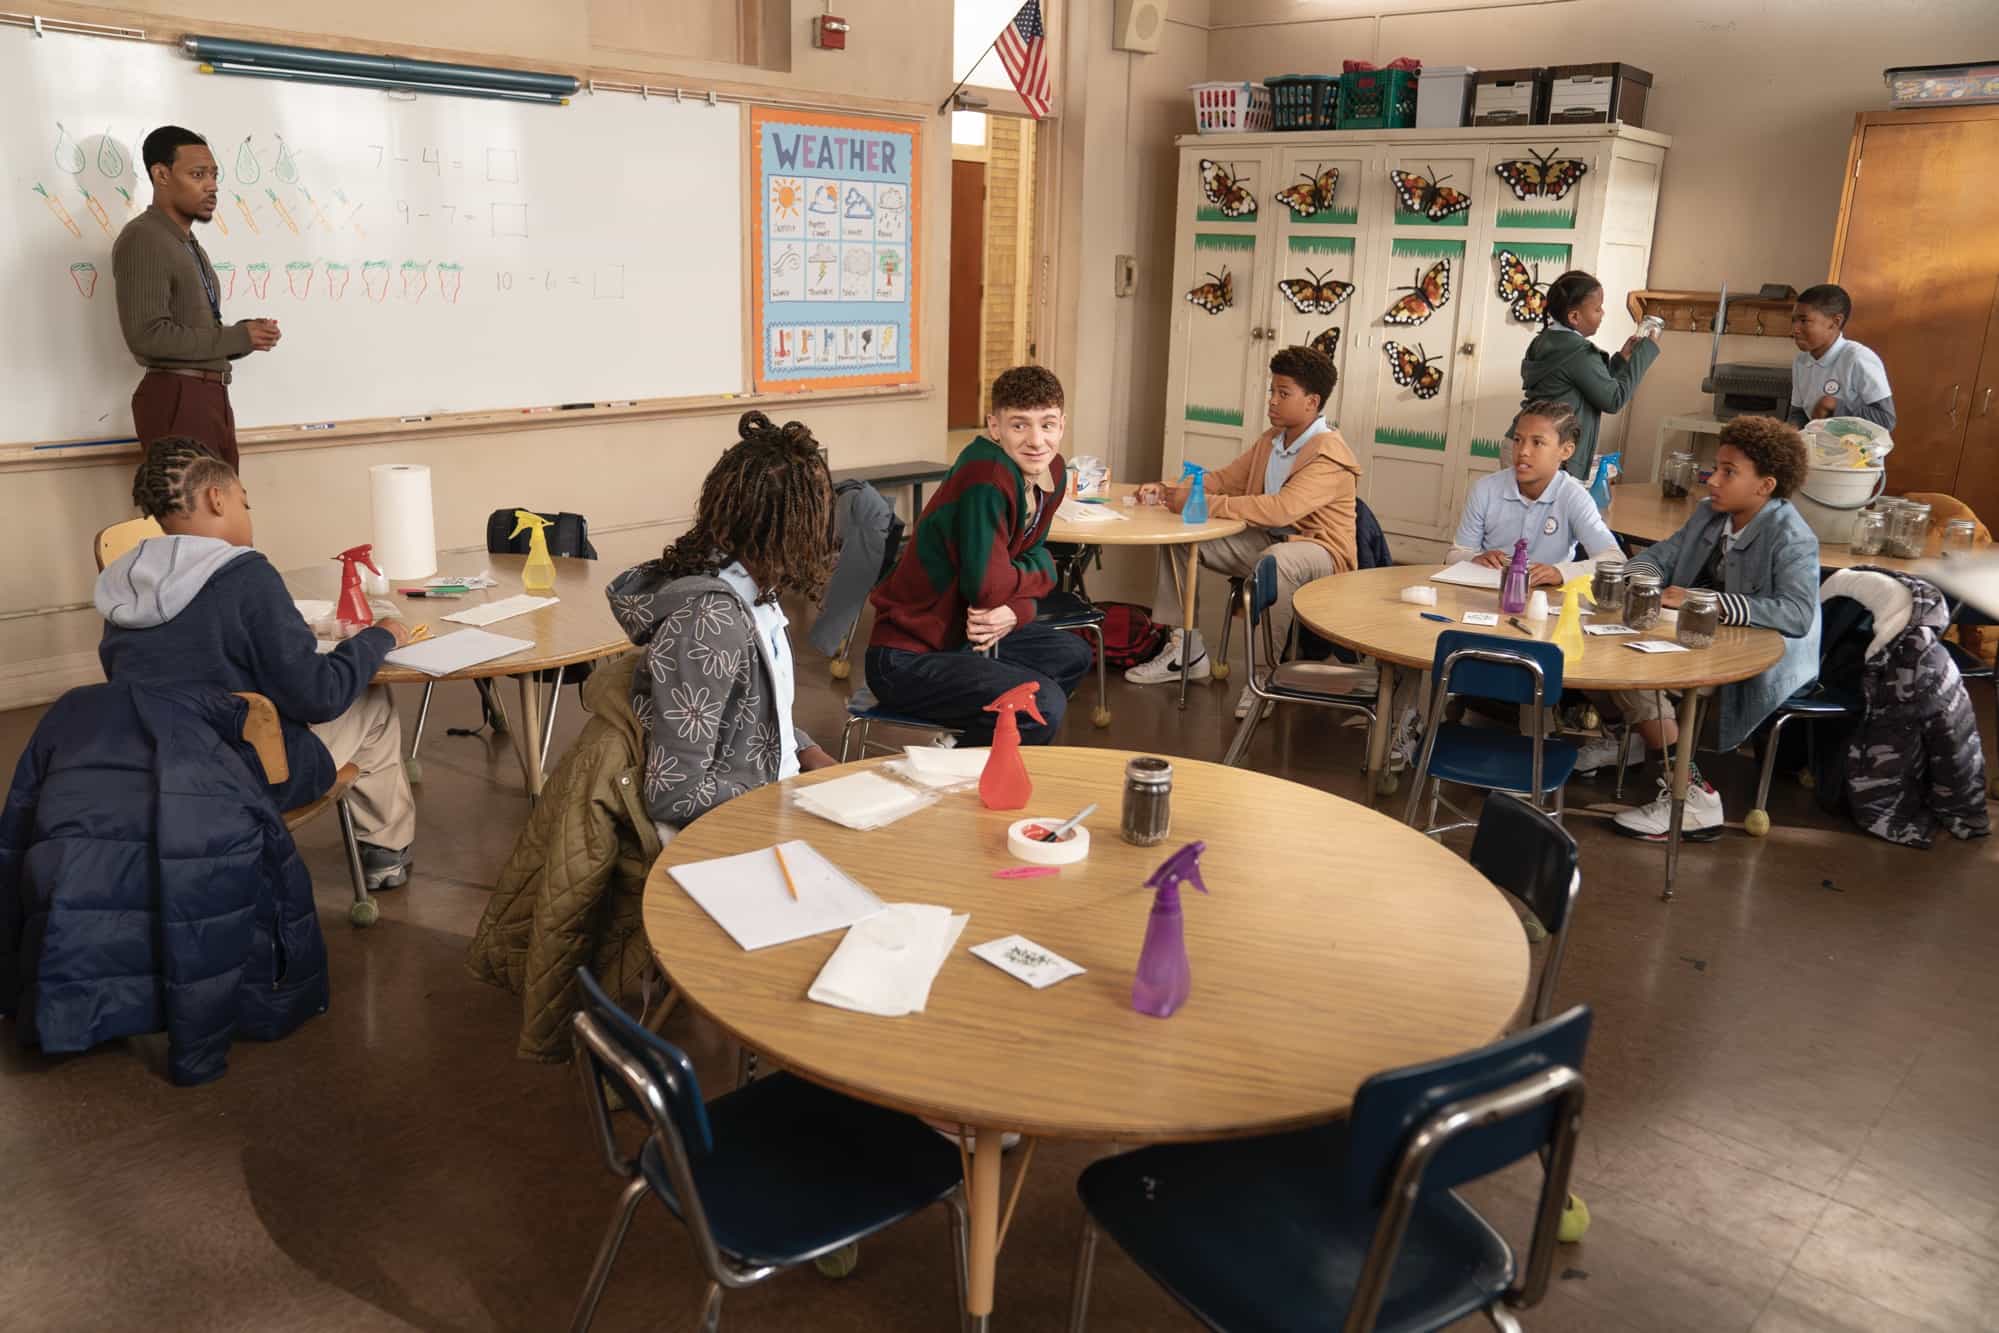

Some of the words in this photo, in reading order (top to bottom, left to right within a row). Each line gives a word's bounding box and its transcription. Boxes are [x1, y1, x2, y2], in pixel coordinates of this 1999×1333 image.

[368, 144, 385, 168] 7
[421, 146, 441, 176] 4
[772, 132, 897, 174] WEATHER
[396, 200, 409, 225] 9
[440, 203, 457, 225] 7
[496, 271, 514, 292] 10
